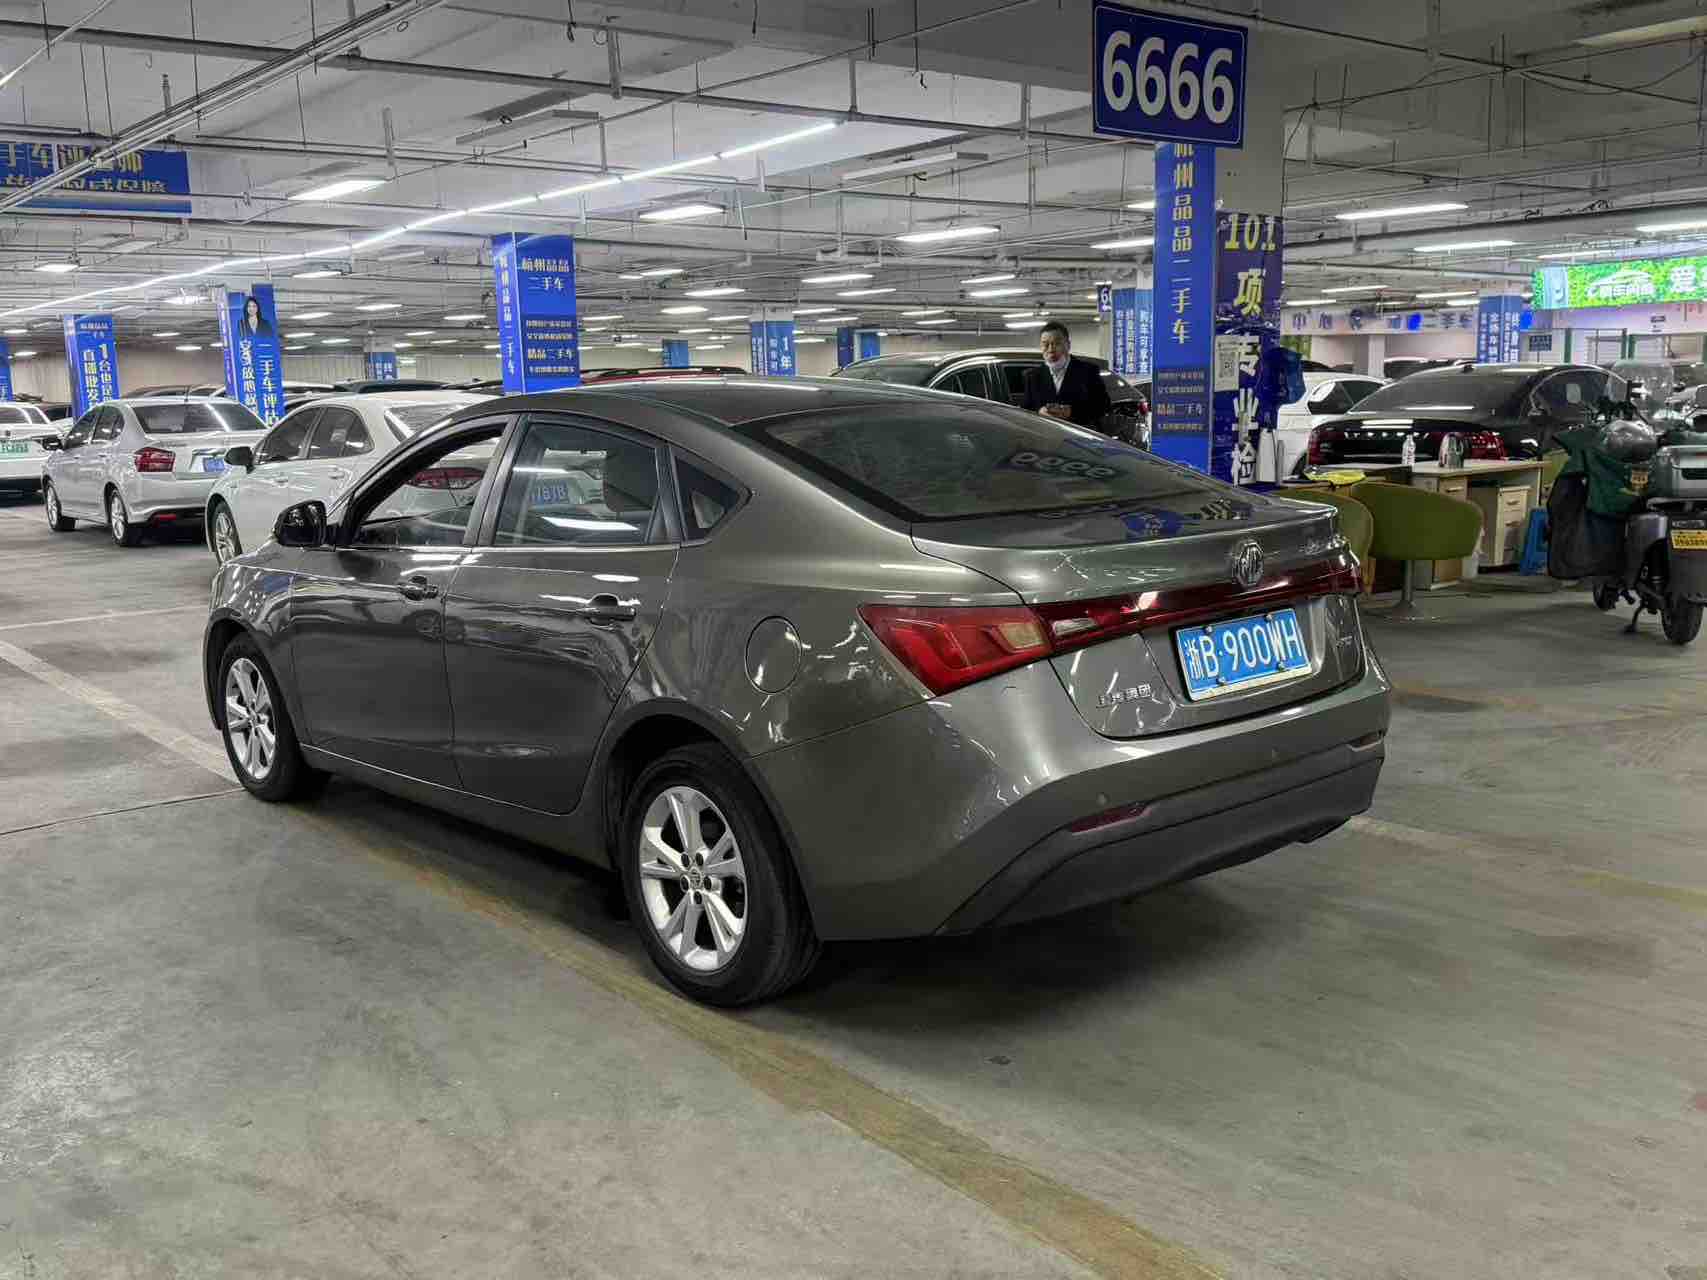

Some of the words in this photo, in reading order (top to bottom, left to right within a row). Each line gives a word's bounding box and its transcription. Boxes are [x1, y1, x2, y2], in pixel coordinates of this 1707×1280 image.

[1103, 30, 1234, 124] 6666
[522, 257, 570, 273] 杭州品品
[527, 276, 566, 291] 二手车
